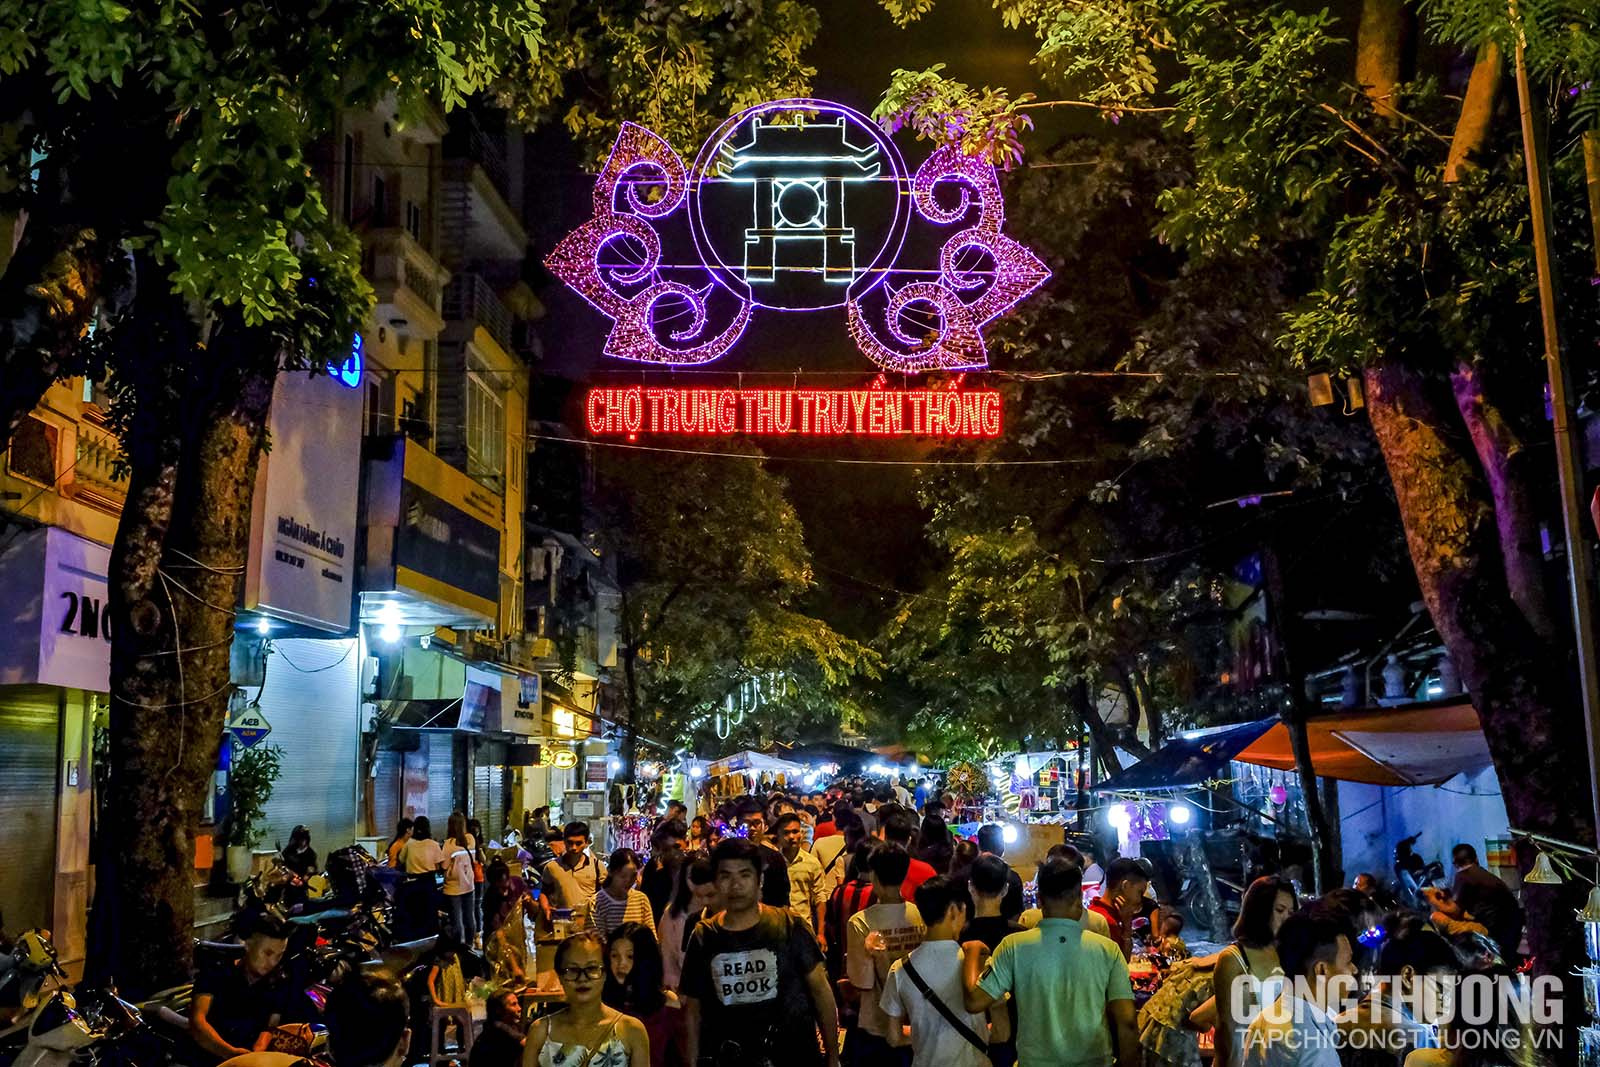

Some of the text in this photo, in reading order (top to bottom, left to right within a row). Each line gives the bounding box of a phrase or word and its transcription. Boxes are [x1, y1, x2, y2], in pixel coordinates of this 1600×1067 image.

[588, 373, 1000, 440] CHỢ TRUNG THU TRUYỀN THỐNG
[723, 960, 766, 977] READ
[722, 978, 771, 997] BOOK
